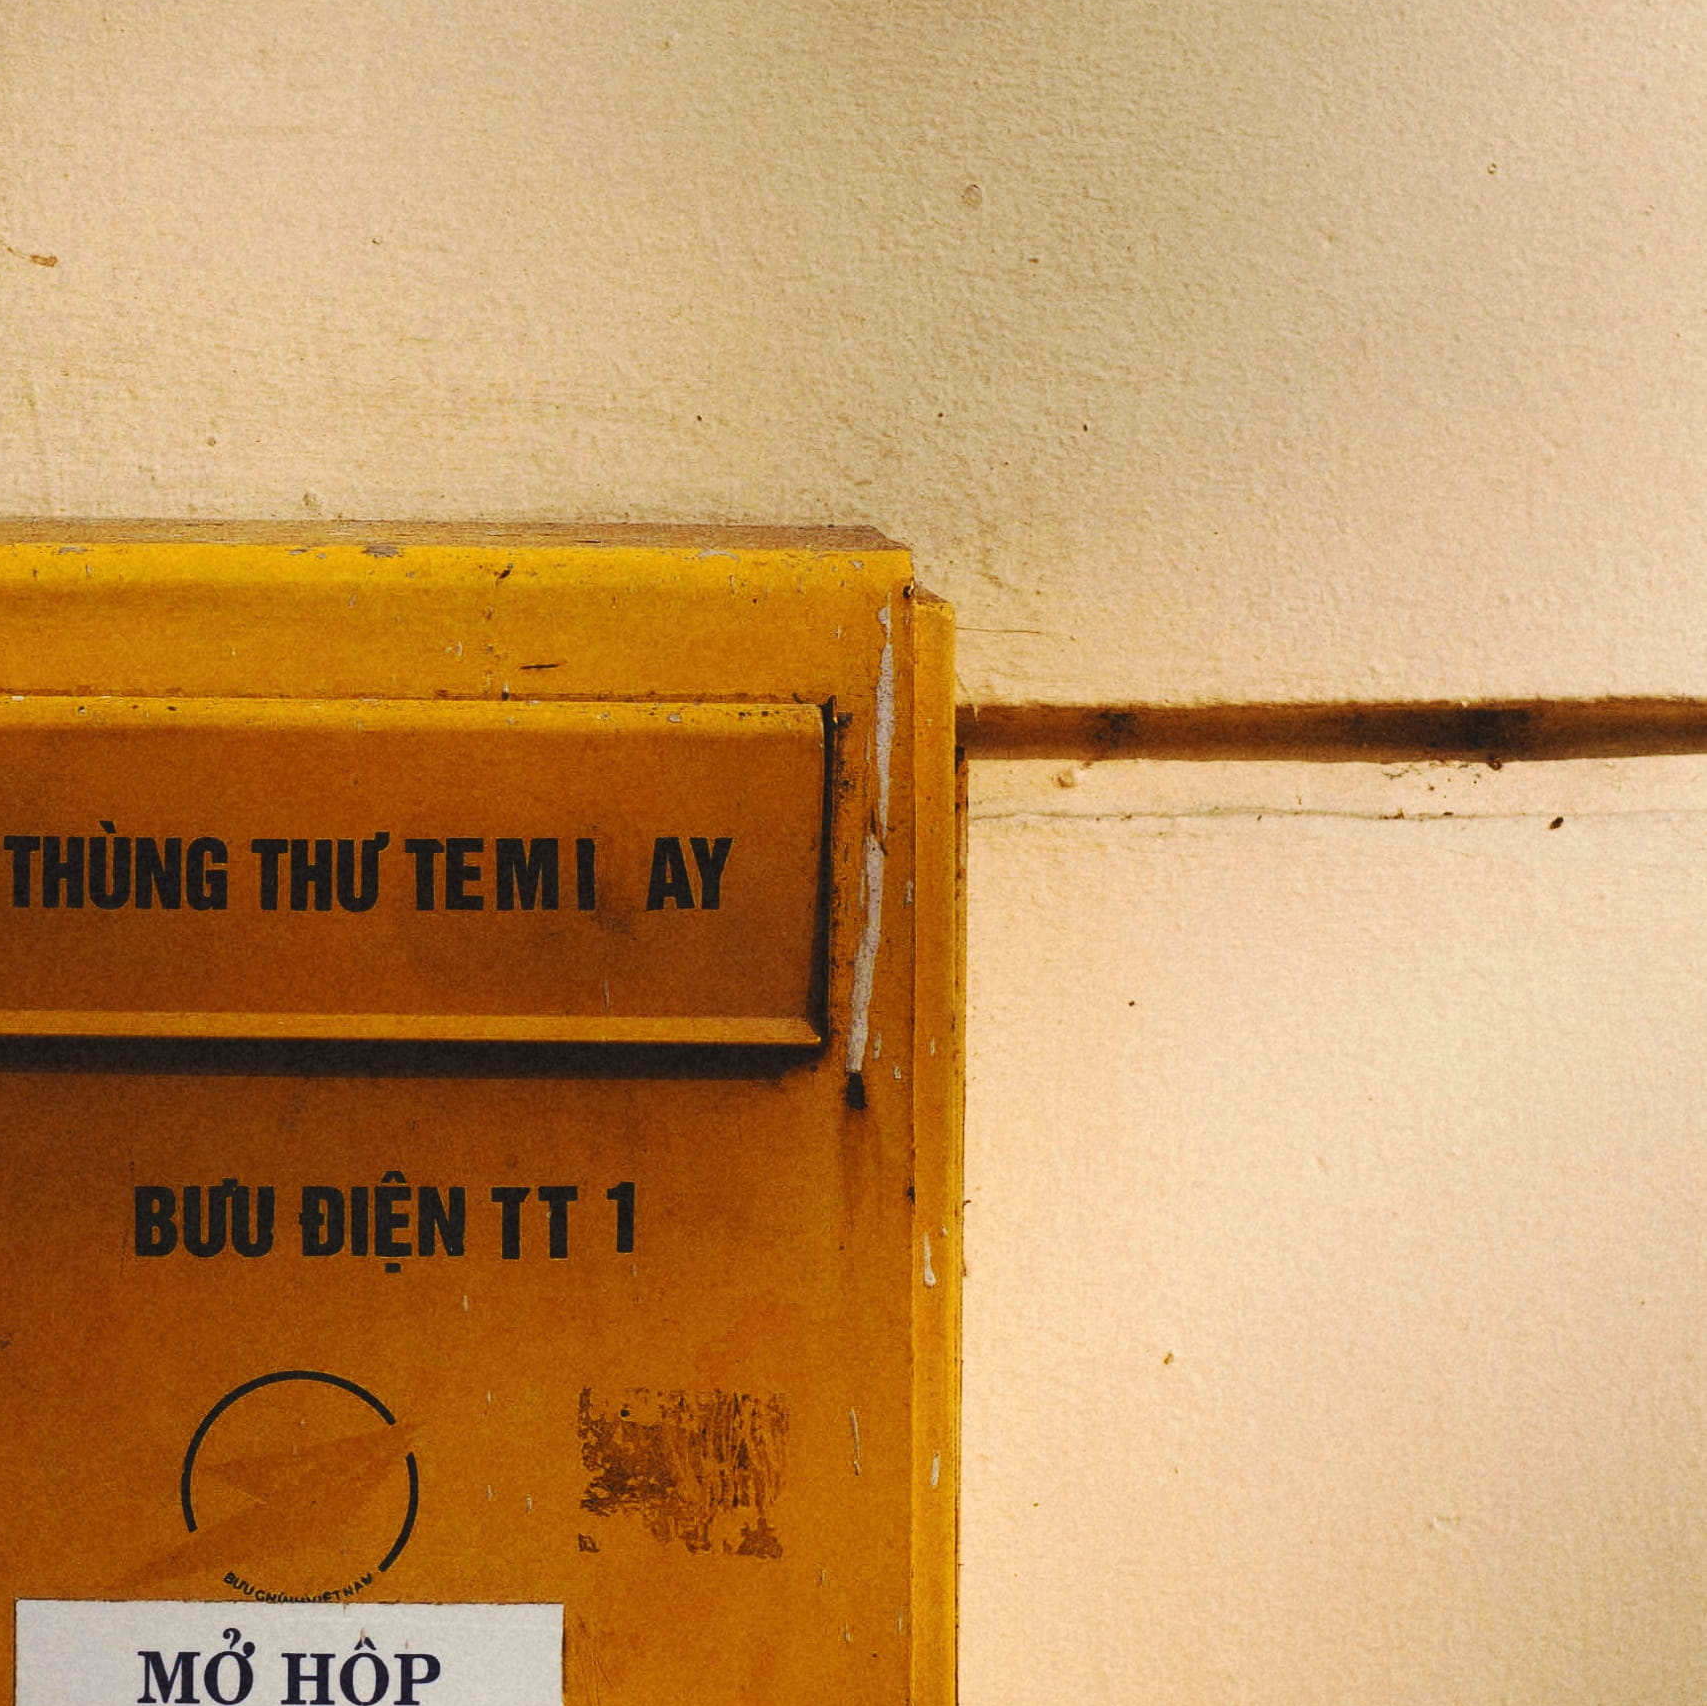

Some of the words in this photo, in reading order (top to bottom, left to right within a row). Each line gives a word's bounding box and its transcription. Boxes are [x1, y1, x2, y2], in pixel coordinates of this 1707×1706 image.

[3, 820, 229, 911] THÙNG
[251, 831, 390, 913] THƯ
[133, 1177, 276, 1258] BƯU
[298, 1170, 466, 1274] ĐIỆN
[491, 1185, 579, 1260] TT
[606, 1181, 636, 1254] 1
[136, 1627, 256, 1706] MỞ
